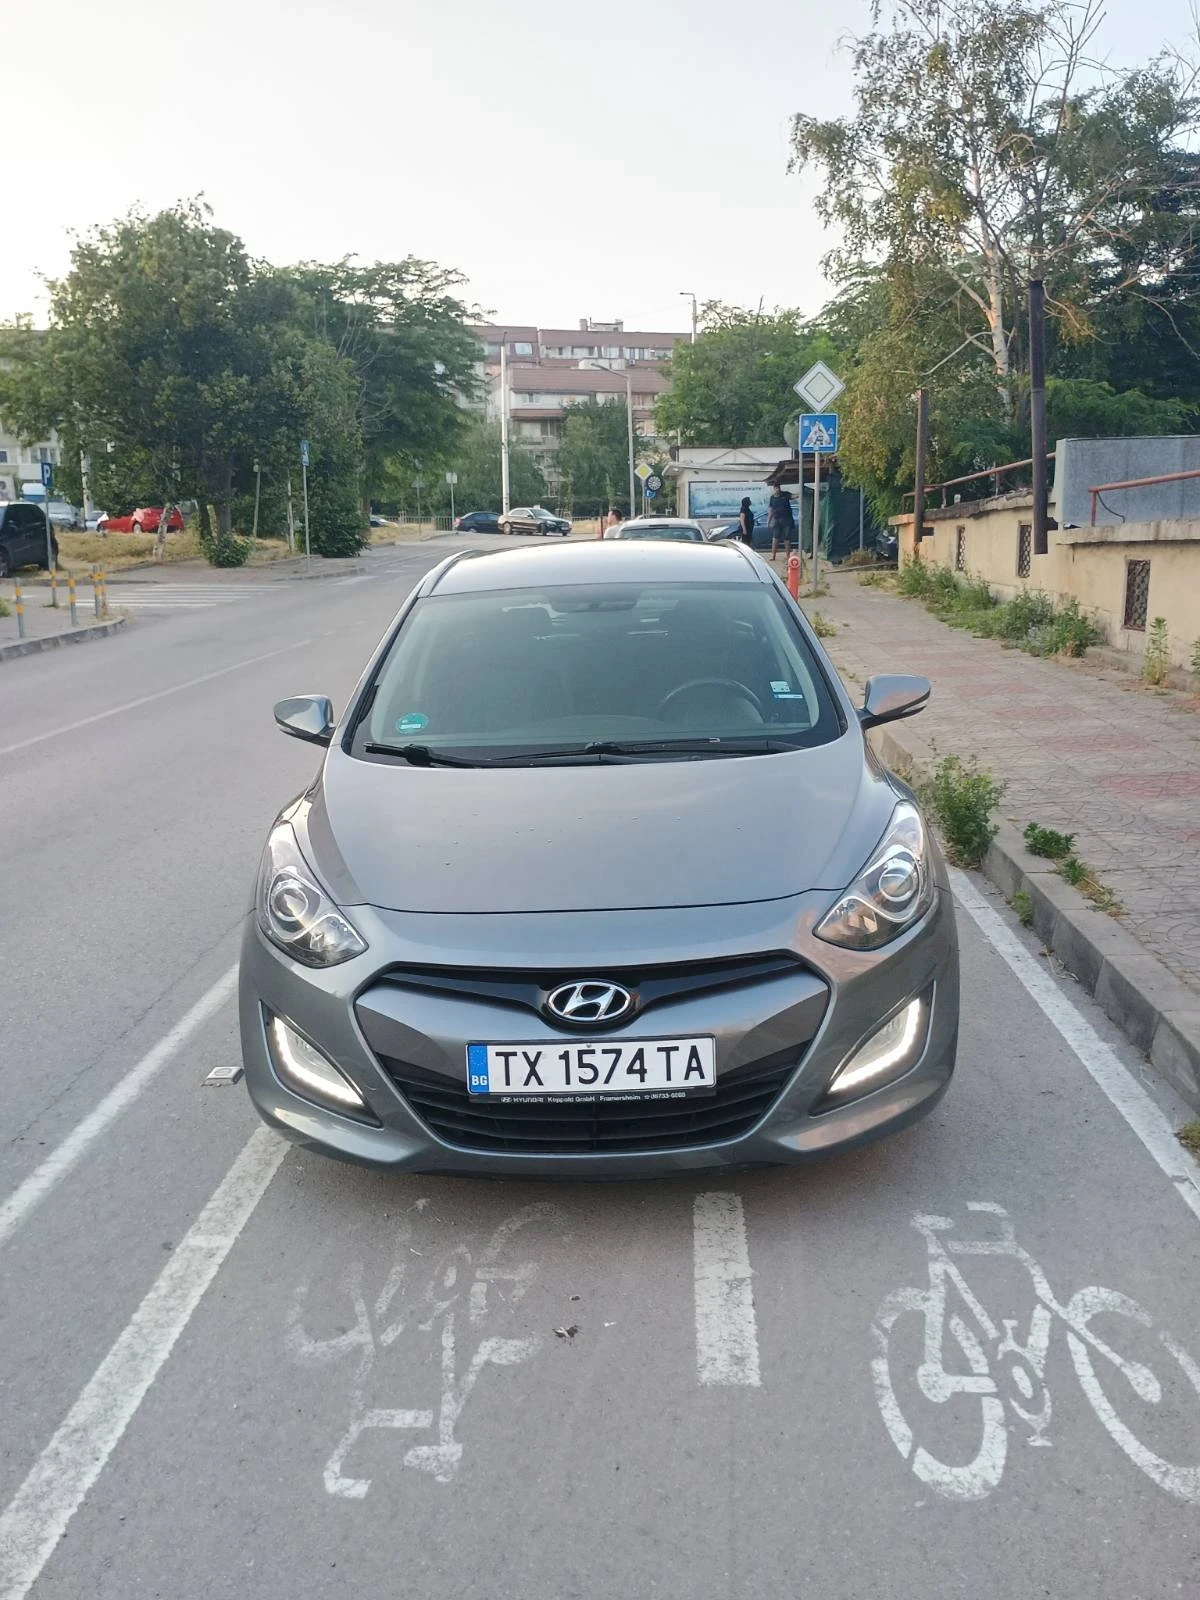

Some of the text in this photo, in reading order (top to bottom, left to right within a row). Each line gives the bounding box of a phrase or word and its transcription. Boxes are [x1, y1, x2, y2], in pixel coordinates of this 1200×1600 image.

[43, 464, 51, 485] P
[495, 1045, 706, 1087] TX 1574 TA
[471, 1075, 488, 1086] BG
[575, 1095, 596, 1103] GmbH
